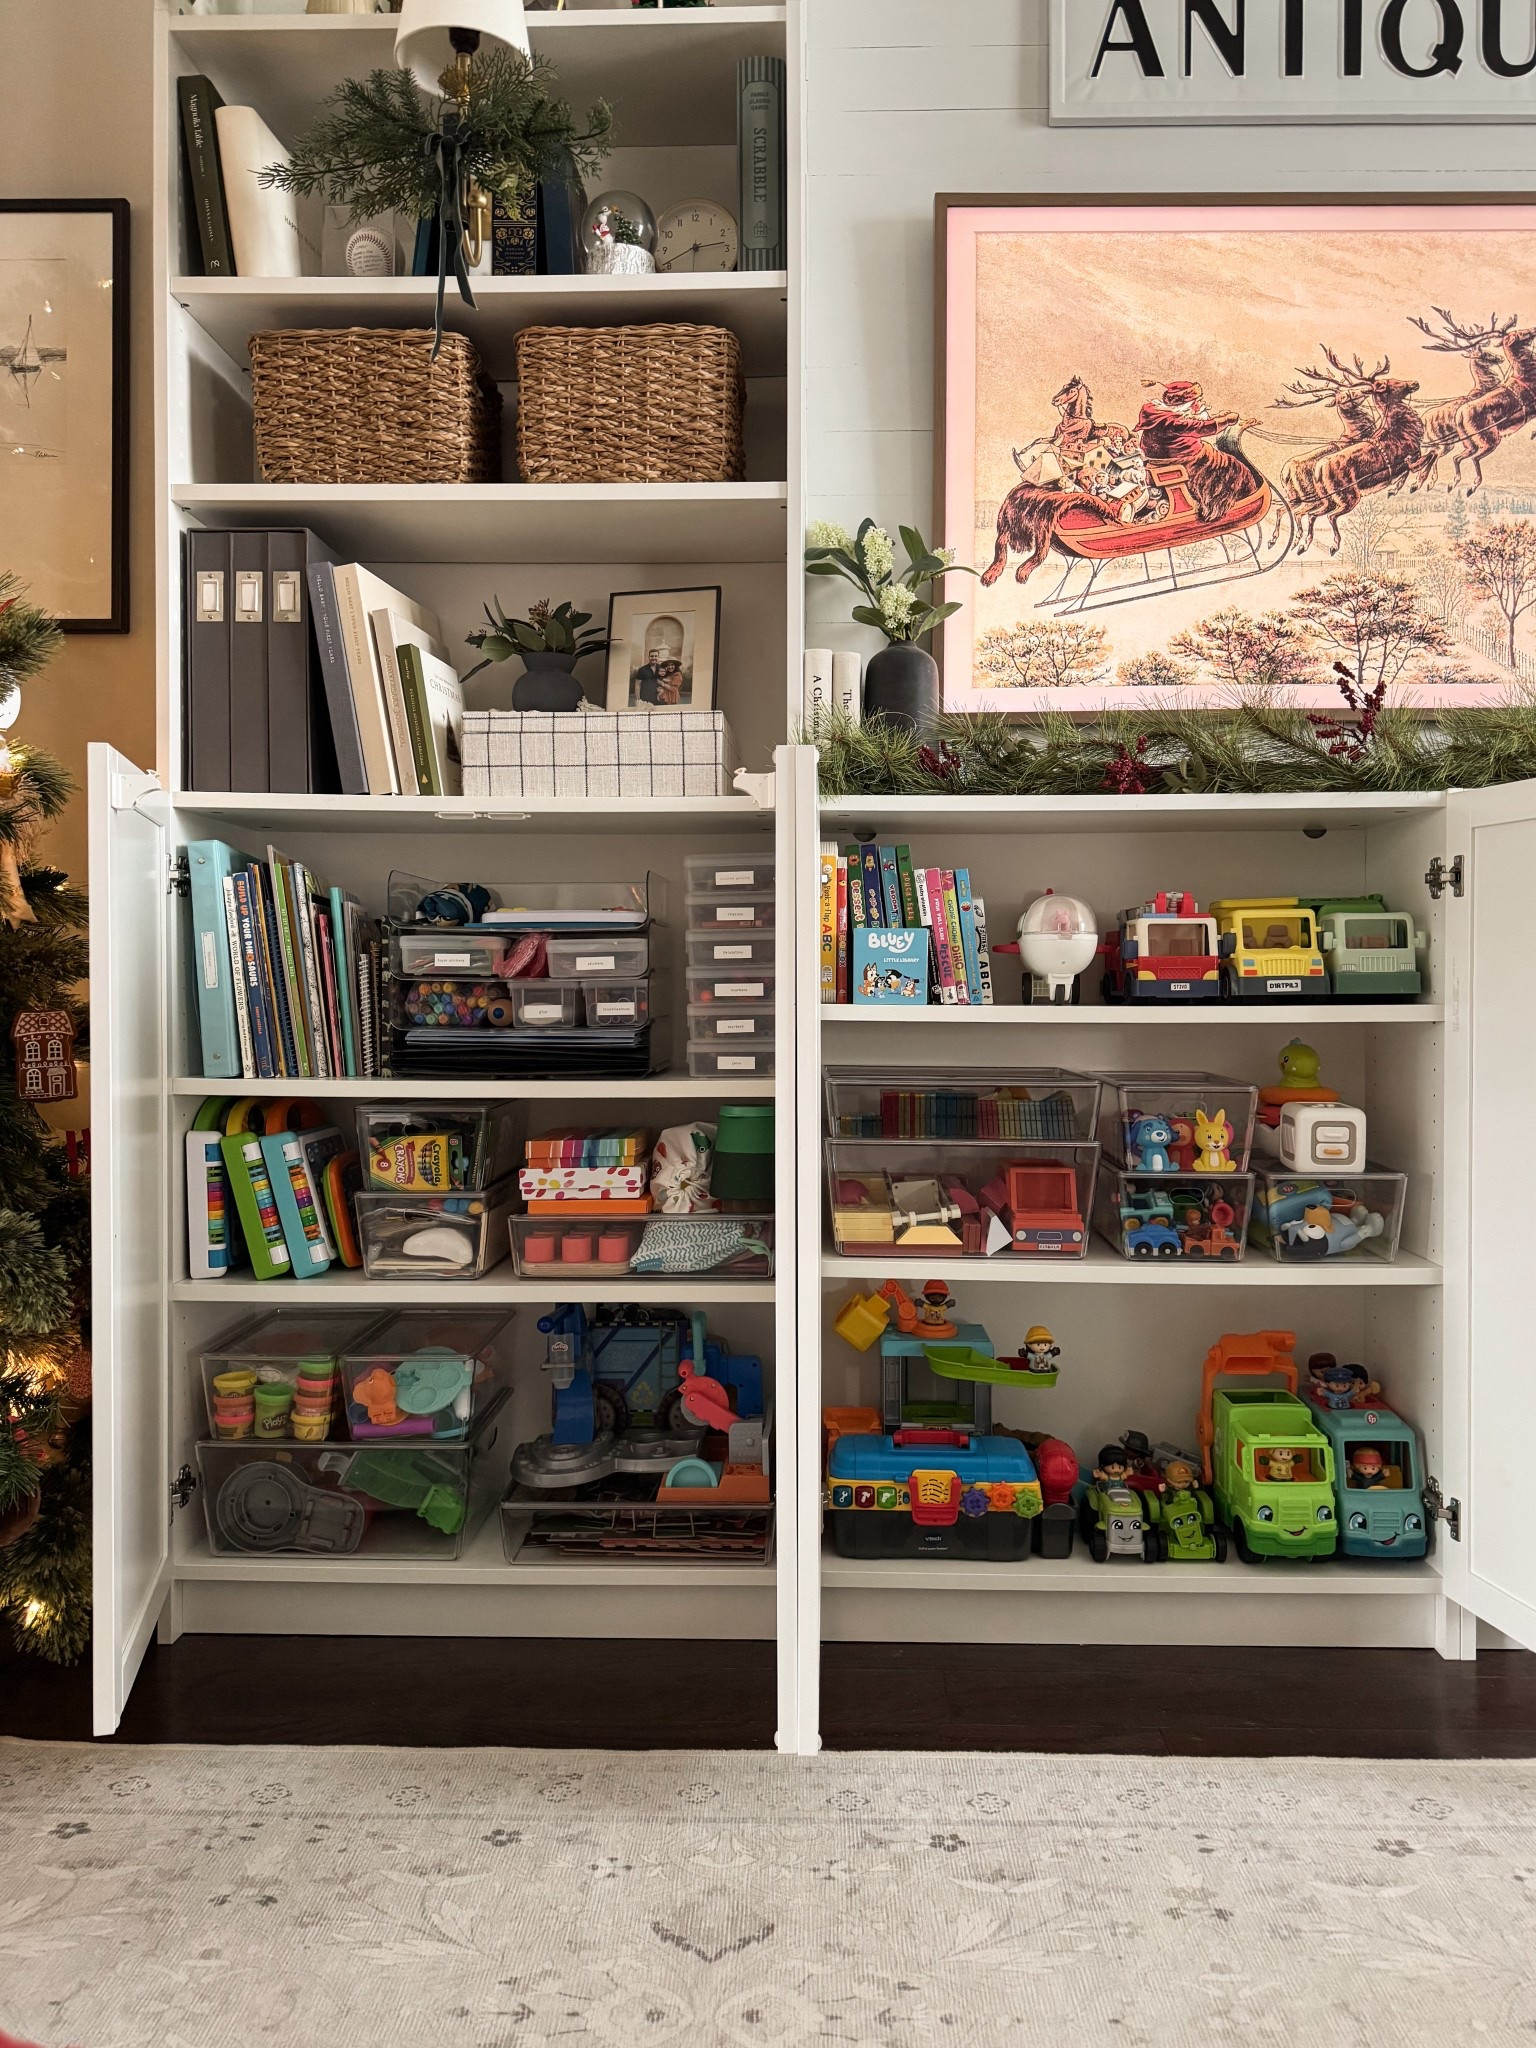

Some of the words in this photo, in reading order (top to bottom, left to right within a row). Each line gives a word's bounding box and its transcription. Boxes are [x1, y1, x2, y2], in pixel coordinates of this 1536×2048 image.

[753, 127, 767, 203] SCRABBLE
[677, 218, 682, 227] 11
[691, 213, 699, 222] 12
[664, 230, 673, 239] 10
[720, 229, 726, 237] 2
[662, 246, 668, 255] 9
[724, 244, 730, 252] 3
[666, 262, 672, 270] 8
[720, 260, 726, 268] 4
[813, 675, 822, 683] A
[842, 689, 852, 710] The
[236, 880, 247, 904] BUILD
[902, 872, 911, 897] TOUCH
[850, 880, 865, 921] Dessert
[239, 906, 248, 917] UP
[241, 918, 252, 939] YOUR
[822, 924, 832, 952] ABC
[950, 921, 958, 944] CHOMP
[232, 940, 240, 965] WORLD
[868, 932, 914, 954] BLUEY
[244, 941, 258, 987] DINOSAURS
[940, 943, 952, 978] RESCUE
[951, 945, 964, 970] DINO
[235, 967, 241, 977] OF
[236, 978, 244, 1011] FLOWERS
[380, 1160, 389, 1169] 8
[393, 1144, 406, 1185] CRAYONS
[433, 1143, 442, 1187] Crayola
